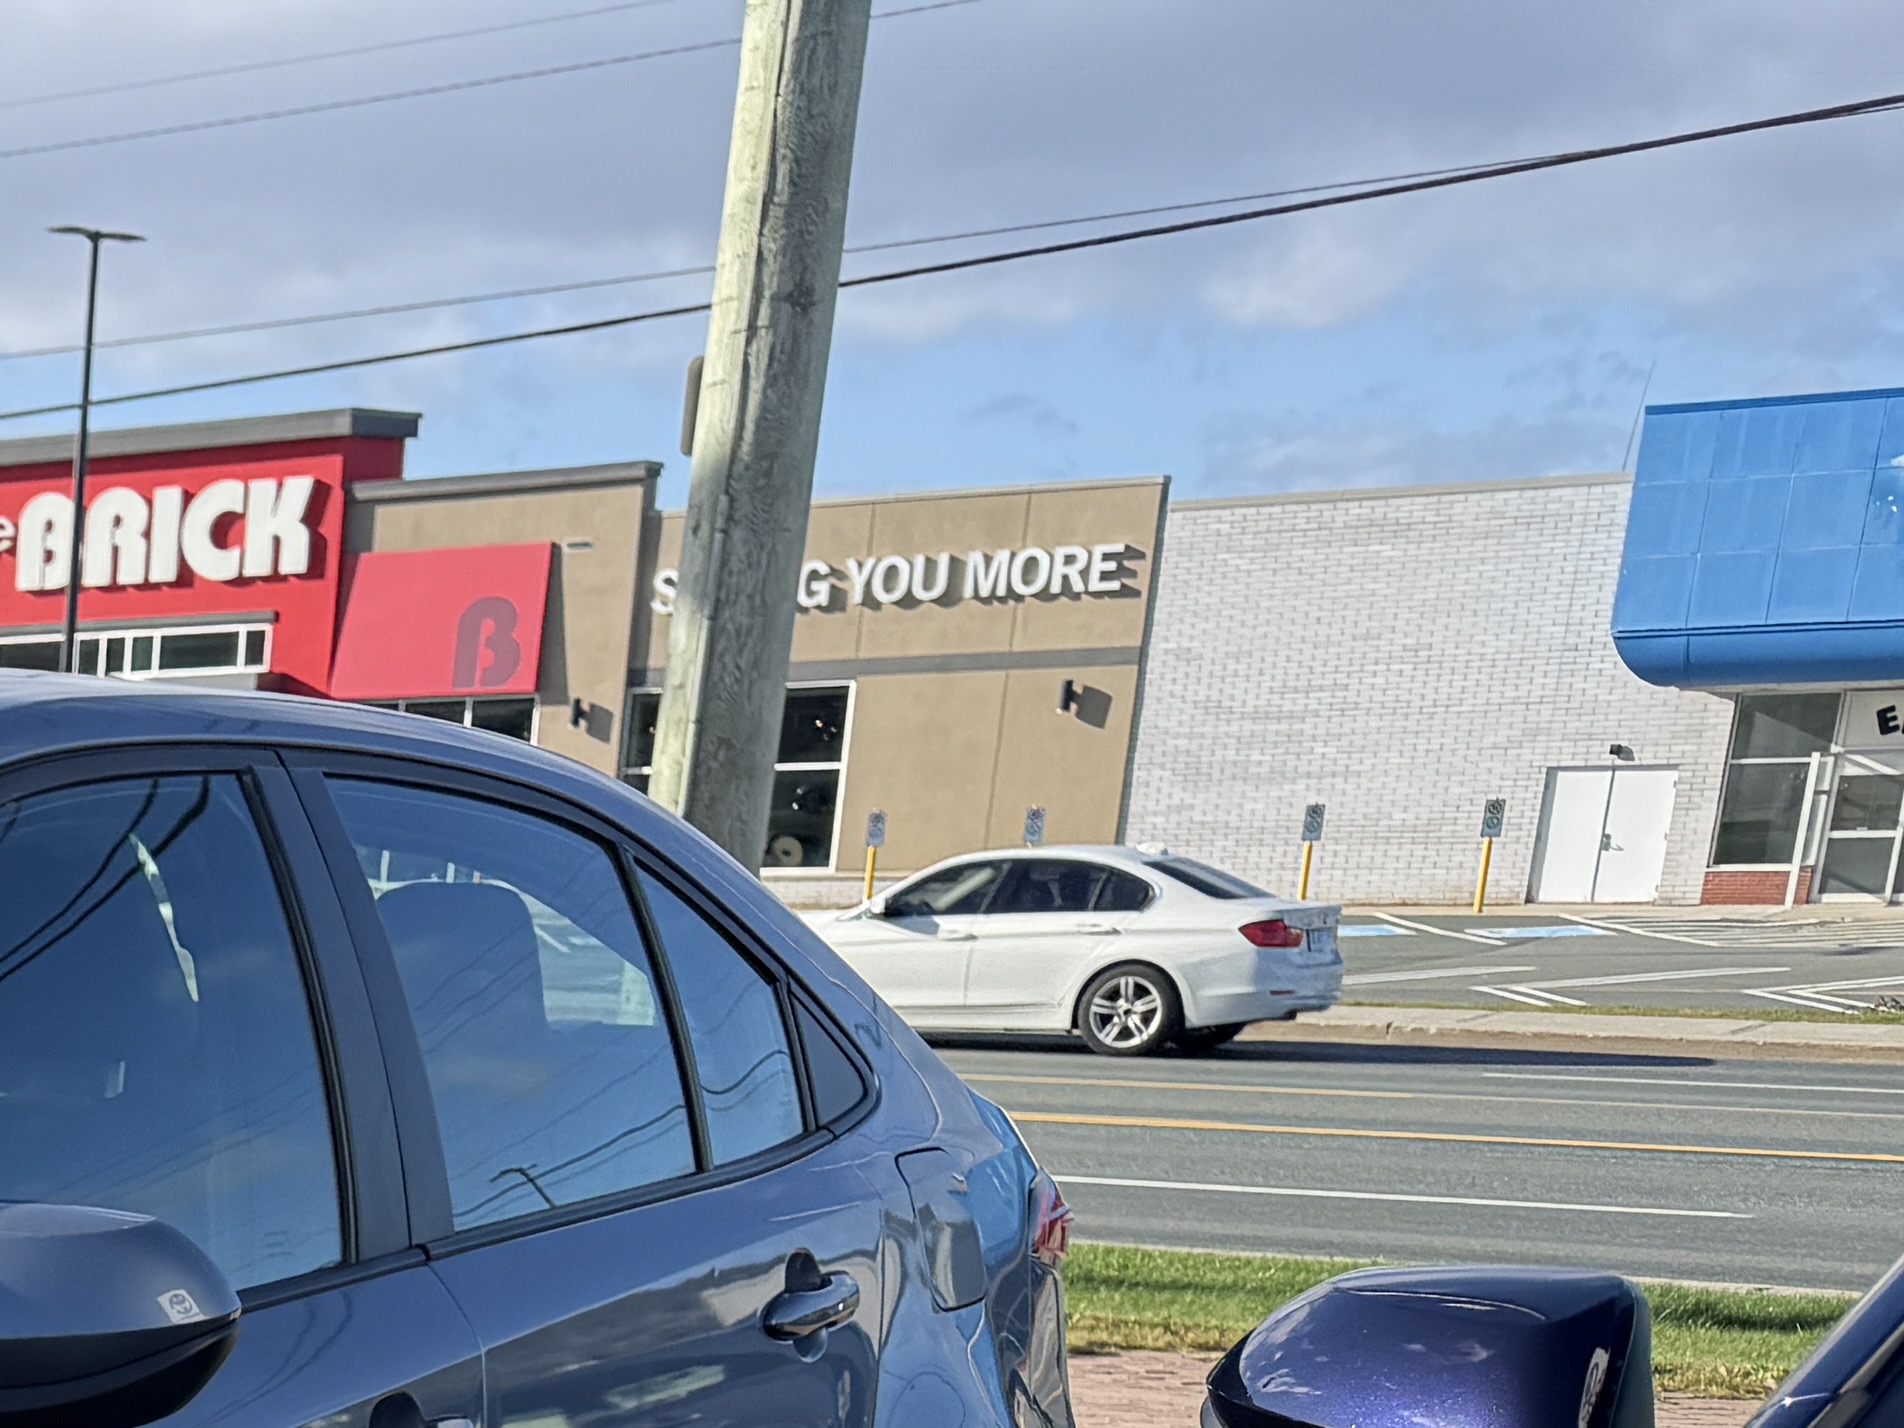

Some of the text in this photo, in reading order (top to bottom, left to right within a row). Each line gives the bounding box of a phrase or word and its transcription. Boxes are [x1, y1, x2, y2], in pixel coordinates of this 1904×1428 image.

[15, 475, 314, 592] BRICK
[846, 552, 950, 605] YOU
[963, 543, 1125, 599] MORE
